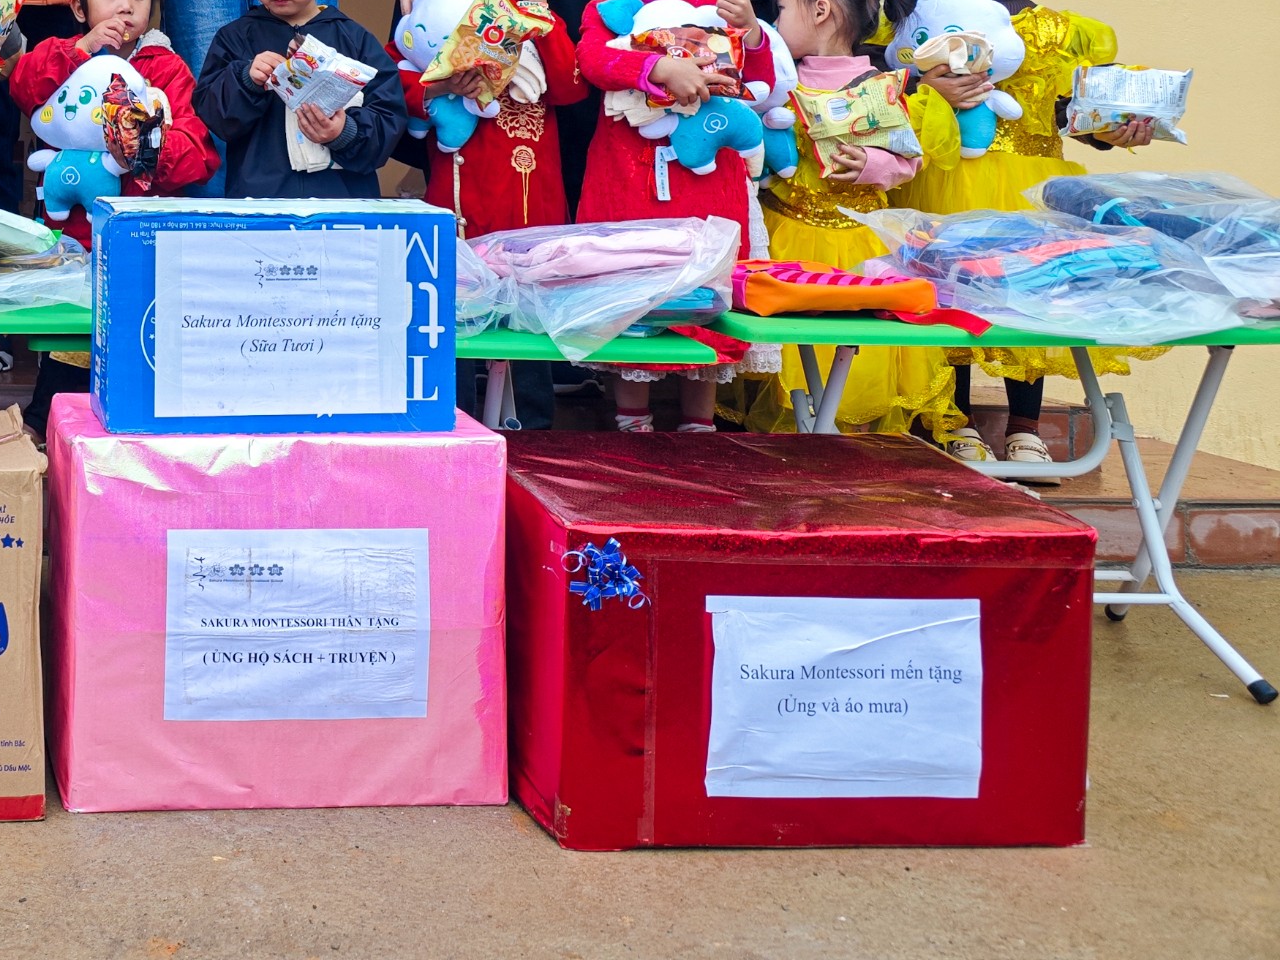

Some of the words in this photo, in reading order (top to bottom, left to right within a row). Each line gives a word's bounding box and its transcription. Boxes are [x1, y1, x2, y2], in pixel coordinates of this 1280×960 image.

[182, 314, 231, 328] Sakura
[236, 314, 314, 328] Montessori
[317, 309, 347, 327] mến
[351, 314, 381, 330] tặng
[250, 339, 276, 353] Sữa
[282, 339, 314, 353] Tươi
[200, 617, 249, 628] SAKURA
[251, 617, 327, 628] MONTESSORI
[330, 615, 362, 627] THÂN
[248, 650, 269, 666] HỘ
[273, 649, 313, 664] SÁCH
[329, 650, 387, 666] TRUYỆN
[740, 664, 795, 680] Sakura
[800, 664, 885, 680] Montessori
[891, 658, 923, 680] mến
[929, 665, 963, 684] tặng
[822, 697, 840, 714] và
[845, 697, 863, 714] áo
[869, 698, 909, 716] mưa)
